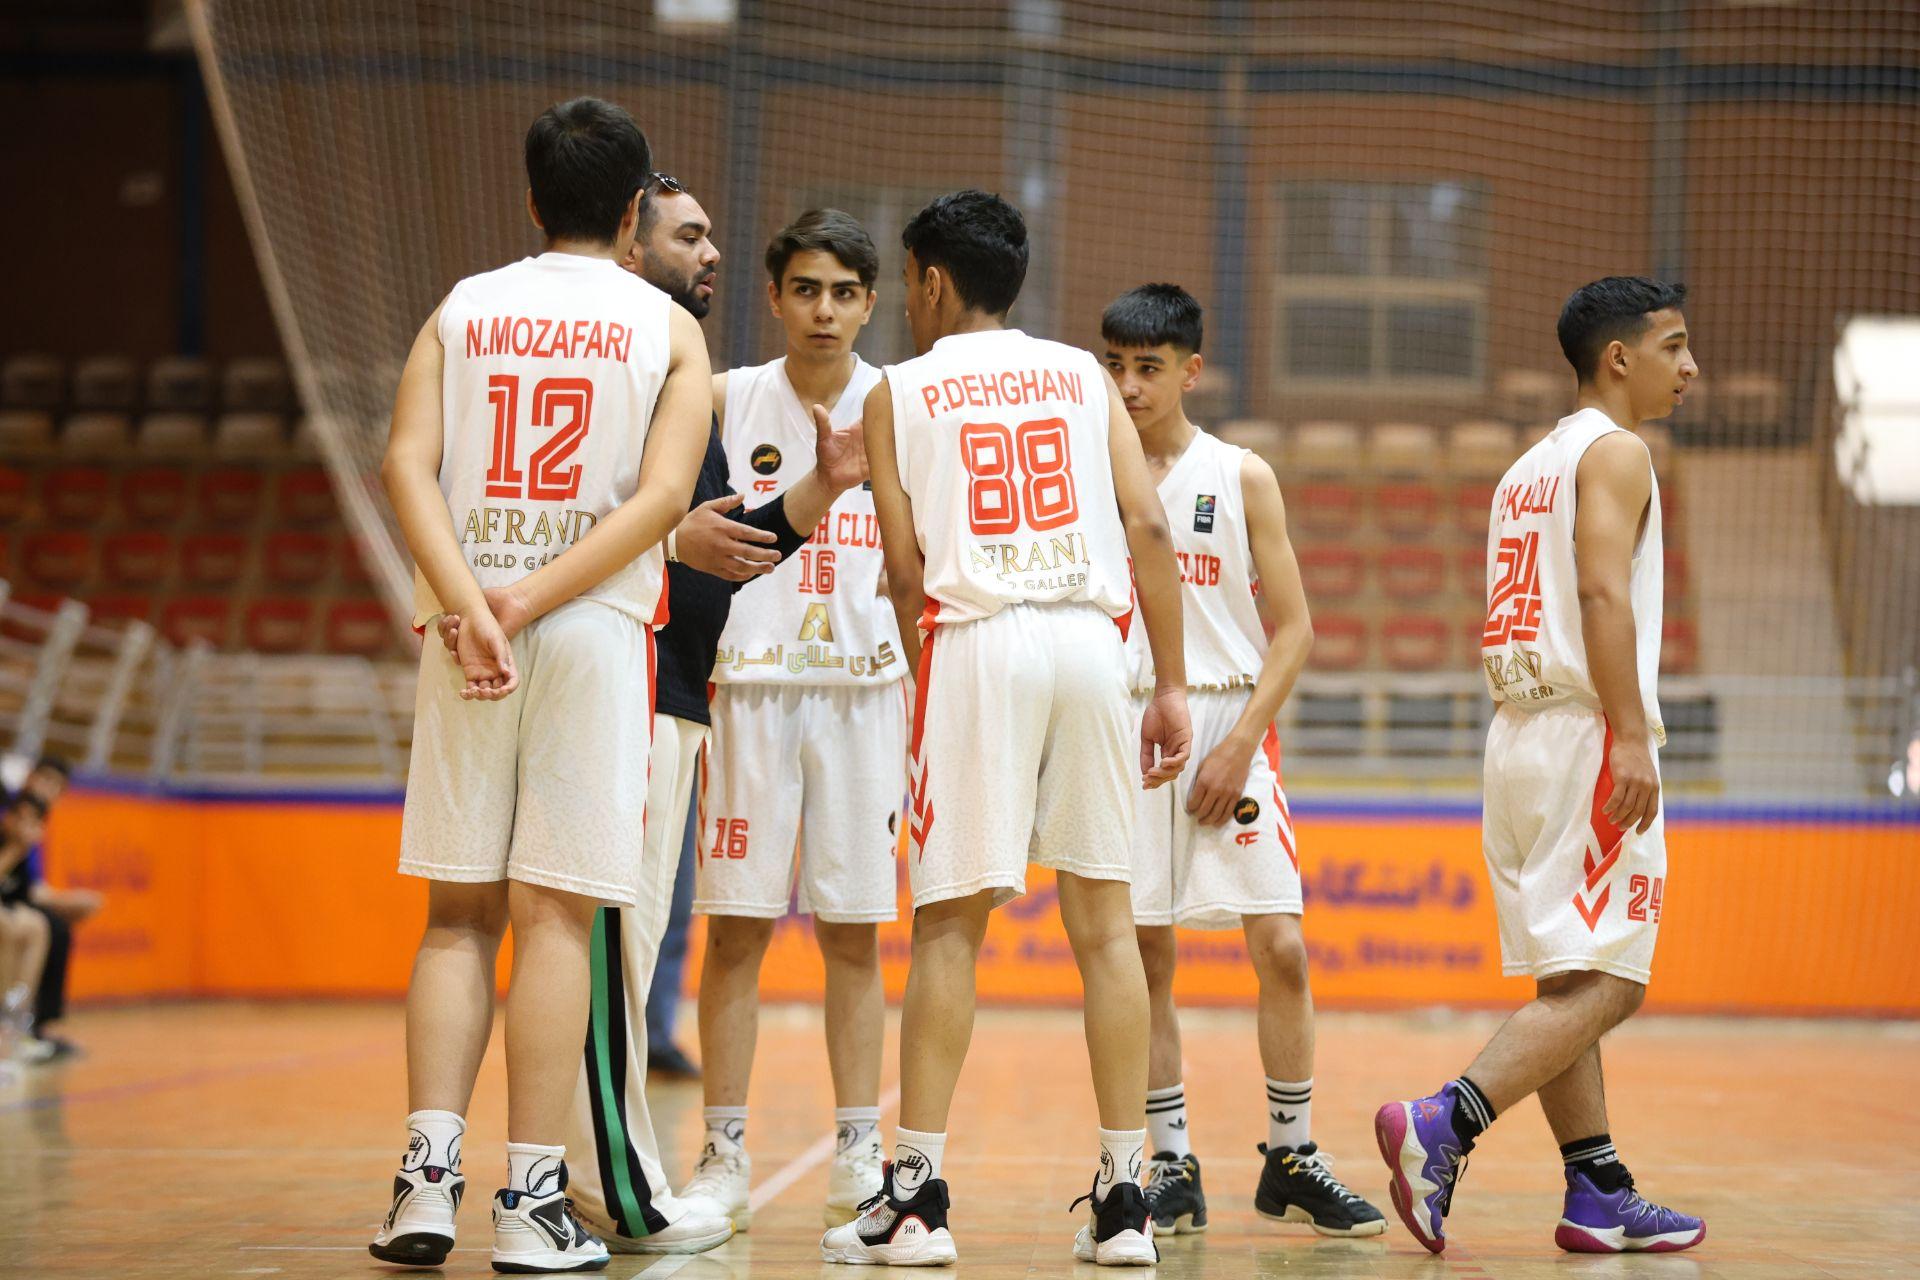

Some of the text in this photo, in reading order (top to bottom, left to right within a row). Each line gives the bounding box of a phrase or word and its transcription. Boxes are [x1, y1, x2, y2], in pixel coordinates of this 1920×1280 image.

[466, 316, 633, 363] N.MOZAFARI
[921, 369, 1083, 418] P.DEHGHANI
[485, 375, 594, 501] 12
[960, 417, 1080, 535] 88
[837, 512, 884, 550] CLU
[798, 549, 836, 595] 16
[1481, 531, 1542, 648] 24
[711, 818, 748, 860] 16
[1628, 874, 1663, 924] 24
